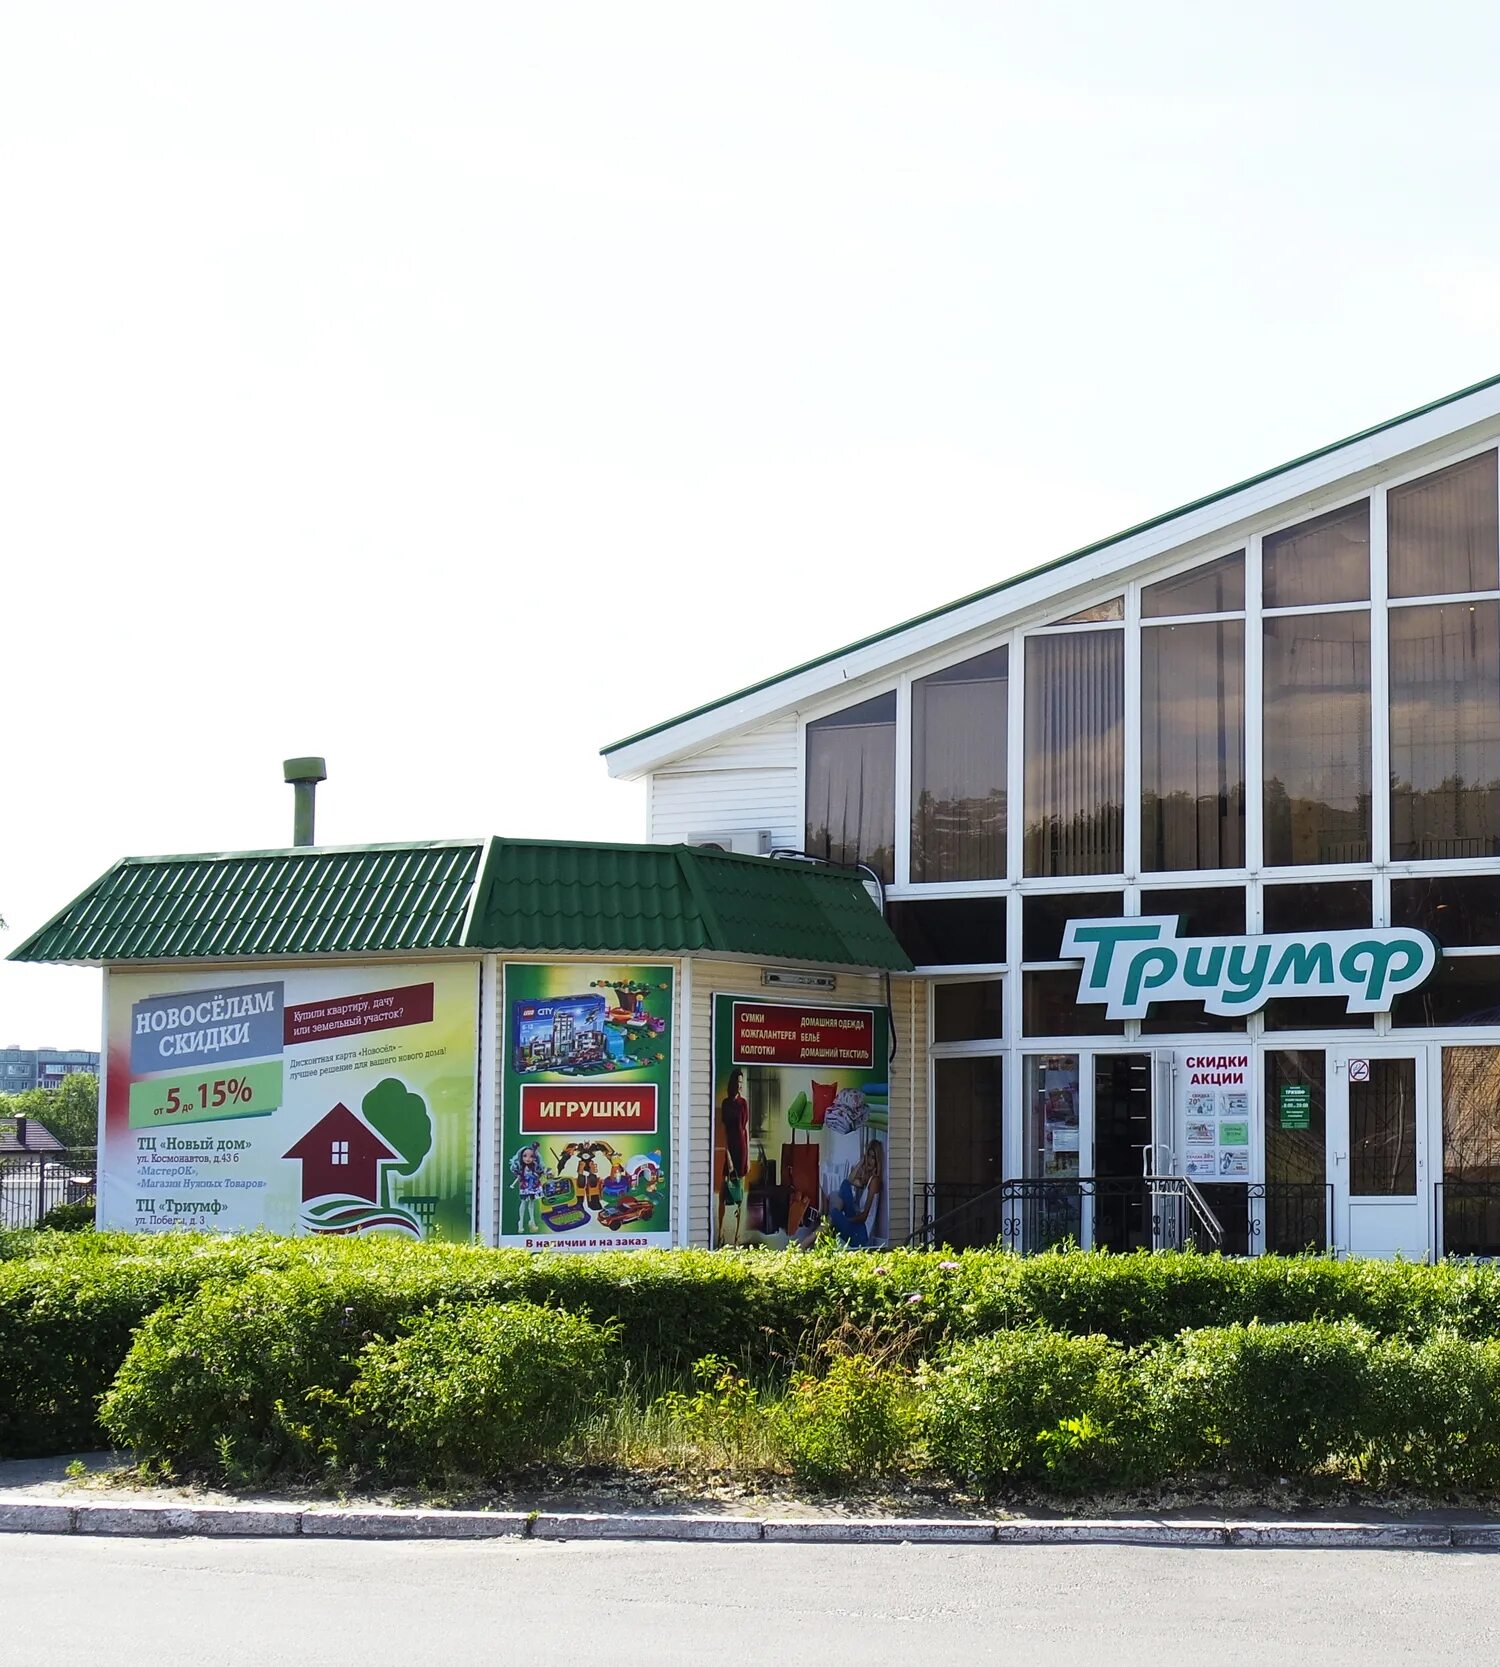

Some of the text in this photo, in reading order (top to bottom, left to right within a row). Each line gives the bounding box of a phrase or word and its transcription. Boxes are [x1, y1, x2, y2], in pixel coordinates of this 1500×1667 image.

[1073, 924, 1424, 1006] Триумф
[136, 990, 275, 1035] НОВОСЁЛАМ
[293, 996, 395, 1023] Купили квартиру, дачу
[293, 1007, 404, 1036] или земельный участок?
[740, 1012, 765, 1024] СУМКИ
[800, 1016, 865, 1031] ДОМАШНЯЯ ОДЕЖДА
[158, 1022, 250, 1057] СКИДКИ
[740, 1028, 797, 1041] КОЖГАЛАНТЕРЕЯ
[800, 1031, 821, 1043] БЕЛЬЁ
[290, 1056, 334, 1070] Дисконтная
[335, 1053, 357, 1065] карта
[358, 1044, 396, 1057] «Новосёл»
[740, 1044, 776, 1056] КОЛГОТКИ
[800, 1046, 870, 1060] ДОМАШНИЙ ТЕКСТИЛЬ
[290, 1046, 448, 1081] лучшее решение для вашего нового дома!
[1185, 1055, 1248, 1070] СКИДКИ
[1190, 1072, 1244, 1087] АКЦИИ
[154, 1076, 253, 1116] от 5 до 15%
[539, 1099, 641, 1119] ИГРУШКИ
[137, 1136, 252, 1152] ТЦ «Новый дом»
[136, 1155, 148, 1165] ул.
[151, 1153, 212, 1164] Космонавтов,
[137, 1178, 267, 1190] «Магазин Нужных Товаров»
[136, 1198, 228, 1216] ТЦ «Триумф»
[135, 1216, 147, 1227] ул.
[189, 1216, 198, 1226] д.
[199, 1215, 205, 1225] 3
[525, 1238, 533, 1248] В
[589, 1238, 597, 1247] и
[599, 1237, 613, 1247] на
[615, 1237, 648, 1247] заказ
